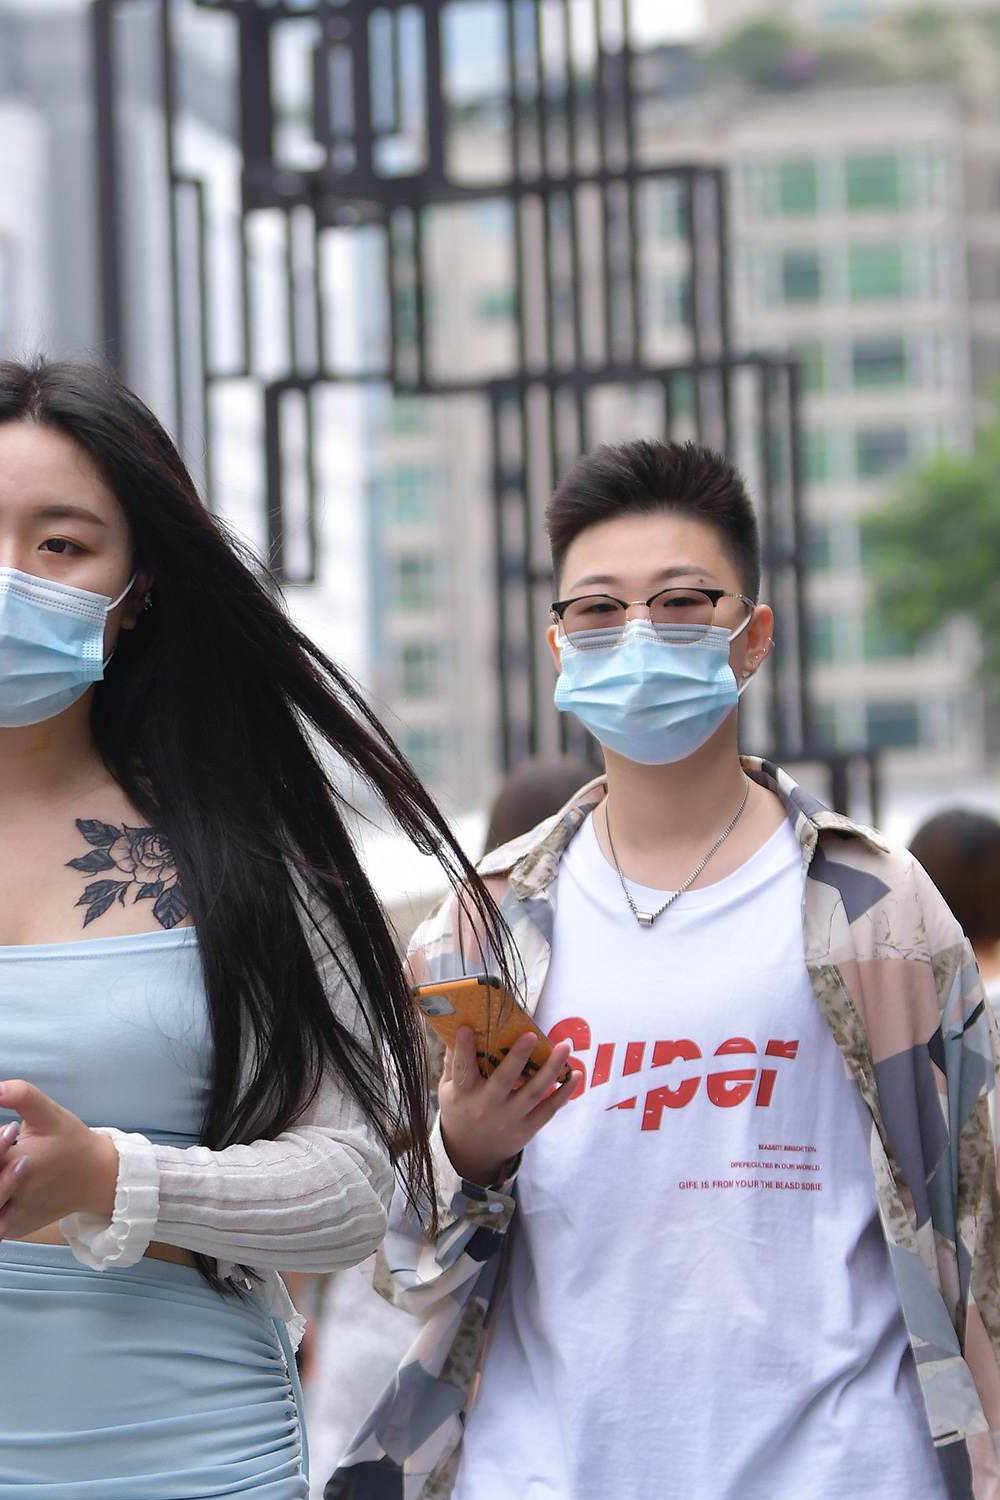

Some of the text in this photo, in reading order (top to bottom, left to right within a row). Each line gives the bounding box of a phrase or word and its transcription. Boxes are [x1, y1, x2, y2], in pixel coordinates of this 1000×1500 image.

[546, 1015, 800, 1132] Super
[701, 1180, 710, 1189] IS
[735, 1179, 760, 1189] YOUR
[760, 1180, 774, 1189] THE
